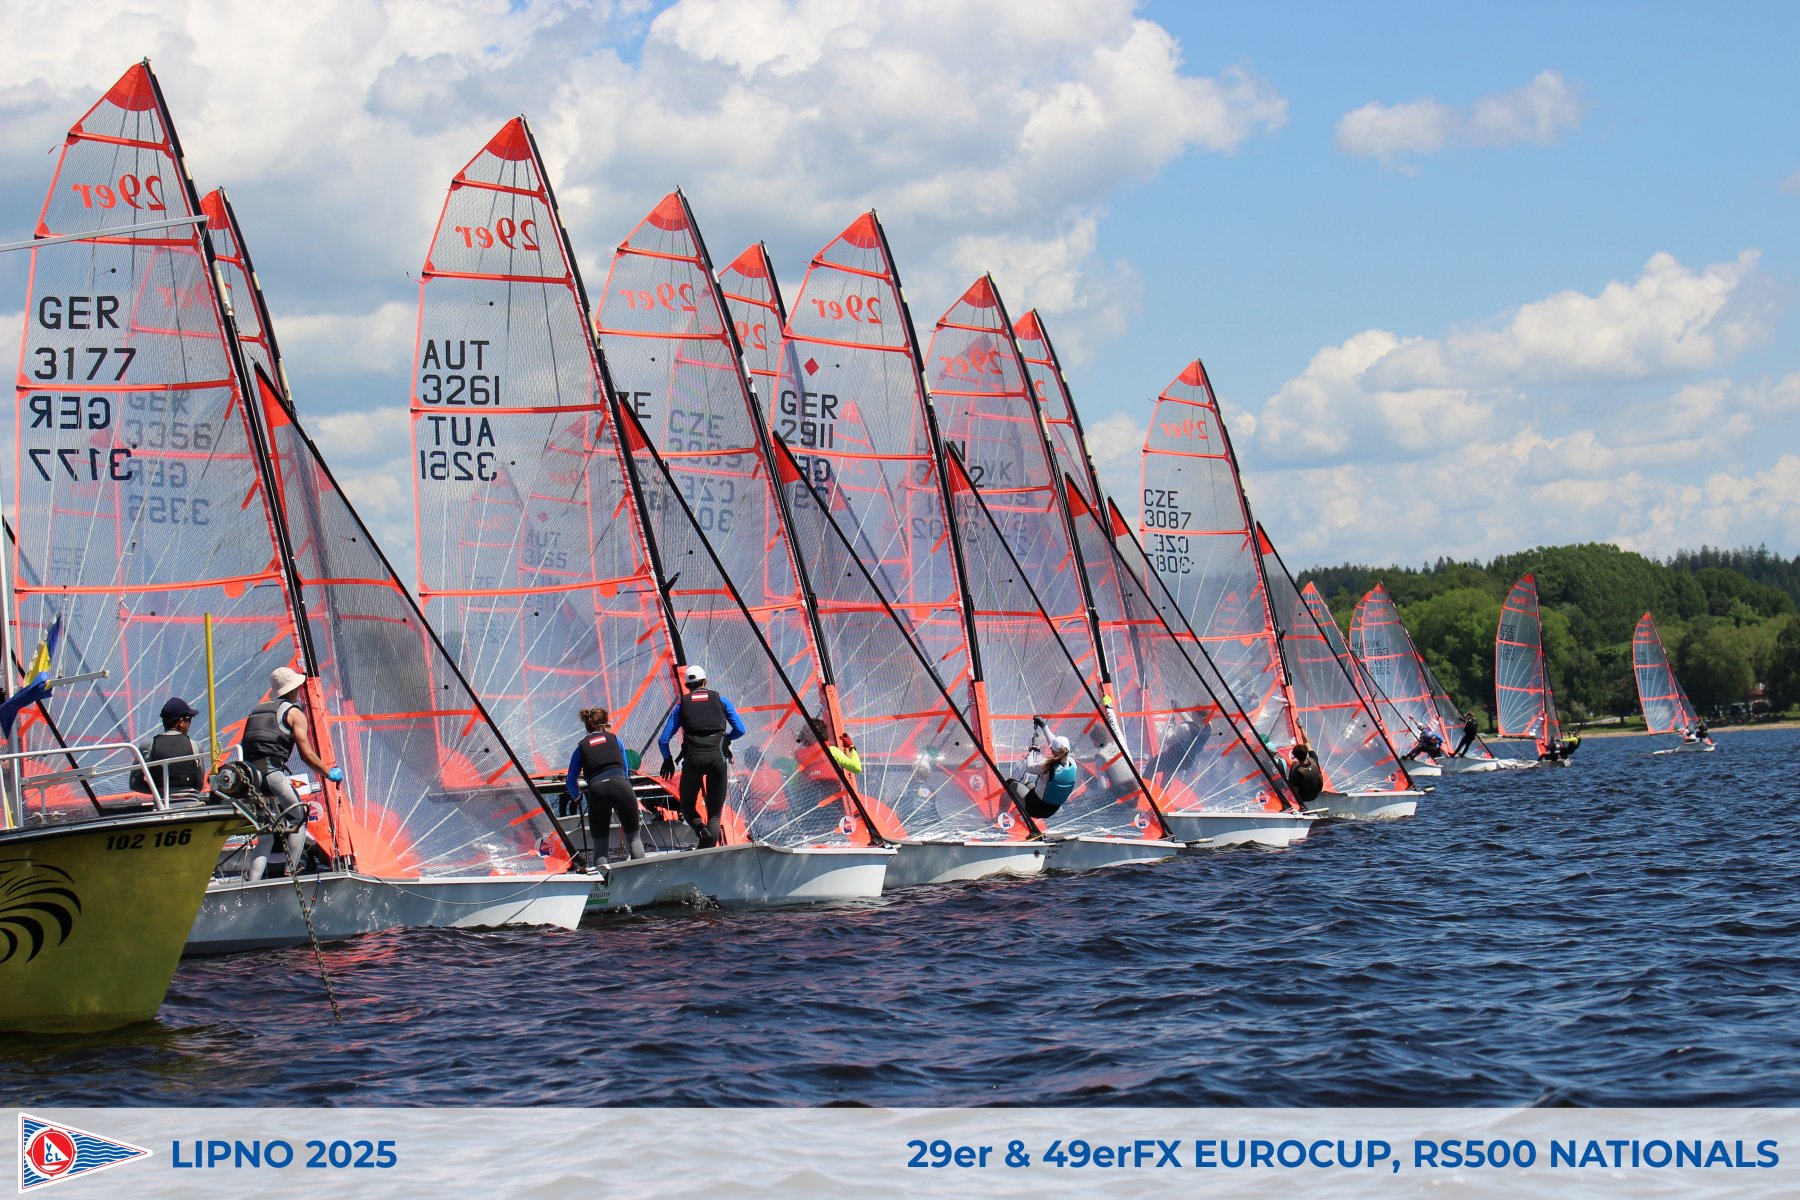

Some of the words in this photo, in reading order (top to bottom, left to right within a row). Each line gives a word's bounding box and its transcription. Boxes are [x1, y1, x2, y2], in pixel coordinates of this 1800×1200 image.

[39, 296, 120, 330] GER
[34, 347, 137, 381] 3177
[422, 339, 490, 371] AUT
[422, 374, 500, 406] 3261
[780, 390, 839, 420] GER
[669, 409, 725, 439] CZE
[780, 418, 834, 449] 2911
[1144, 488, 1179, 509] CZE
[1144, 509, 1192, 530] 3087
[106, 834, 144, 850] 102
[153, 828, 192, 848] 166
